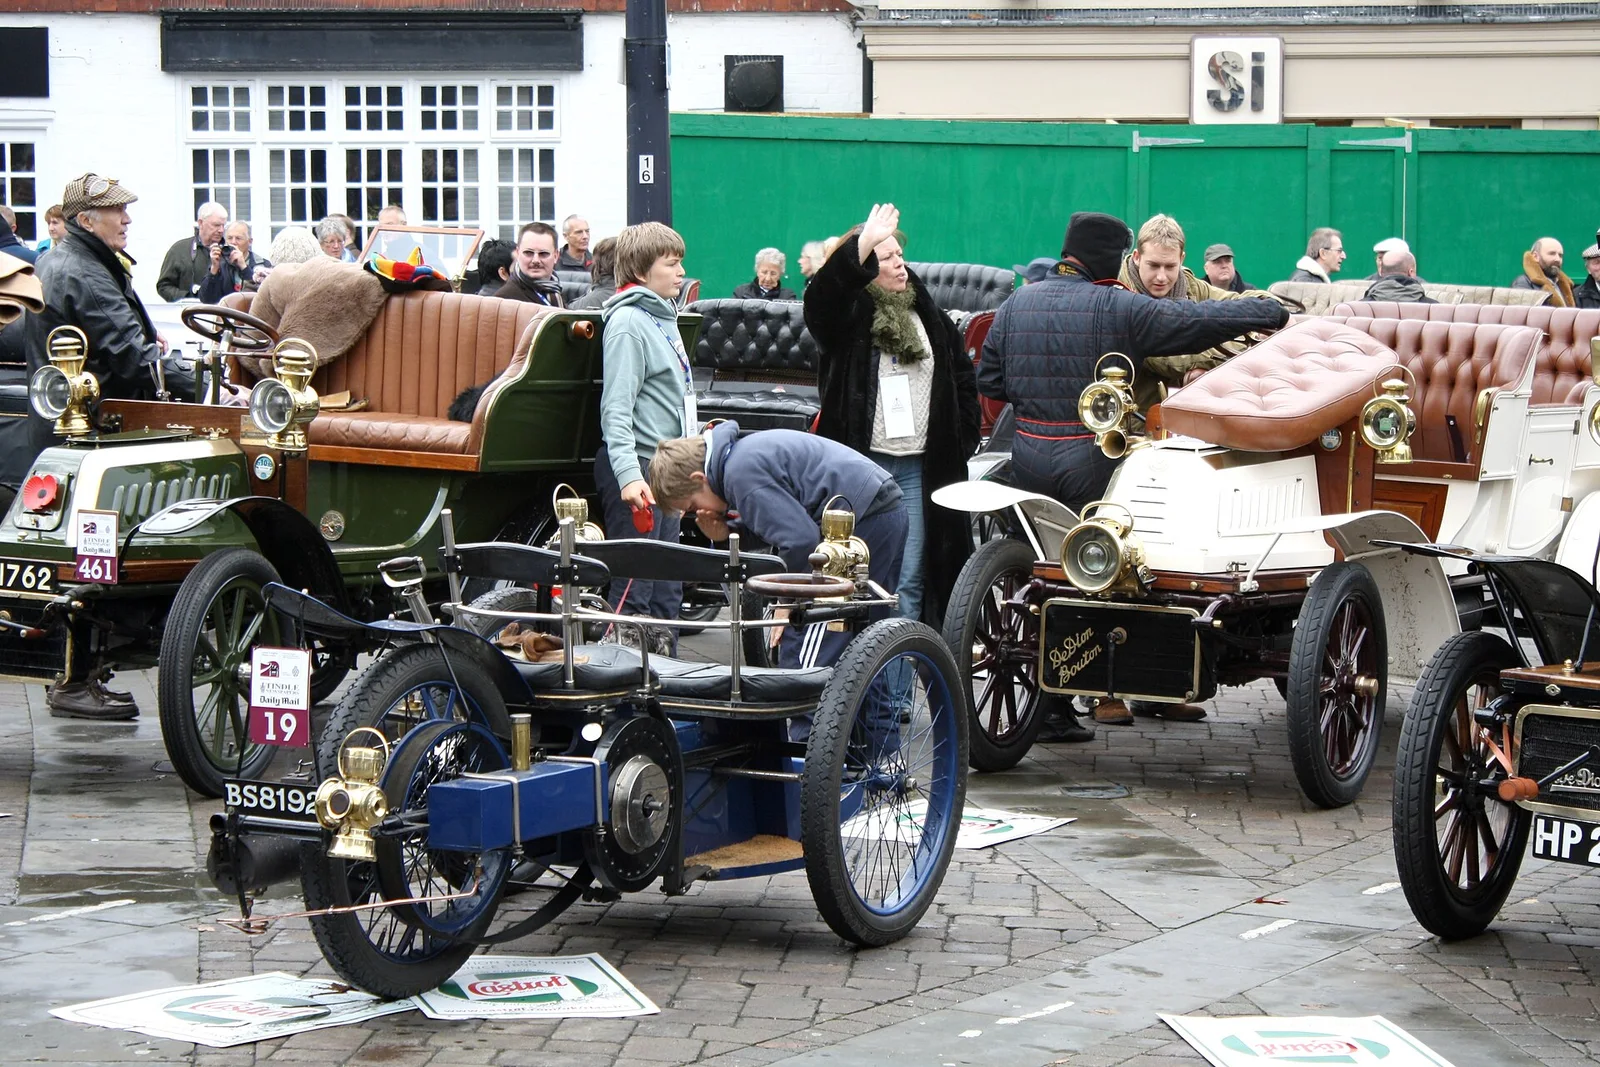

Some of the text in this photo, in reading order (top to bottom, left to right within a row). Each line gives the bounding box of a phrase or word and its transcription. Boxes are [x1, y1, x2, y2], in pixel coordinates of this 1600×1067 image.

[1206, 50, 1265, 113] Si
[82, 546, 98, 554] Daily
[78, 558, 112, 580] 461
[1059, 644, 1102, 688] Bouton
[266, 682, 300, 691] TINDLE
[259, 695, 300, 706] Daily Mail
[264, 711, 297, 742] 19
[225, 783, 317, 815] BS8192
[1535, 818, 1583, 859] HP
[467, 975, 568, 997] Castrol
